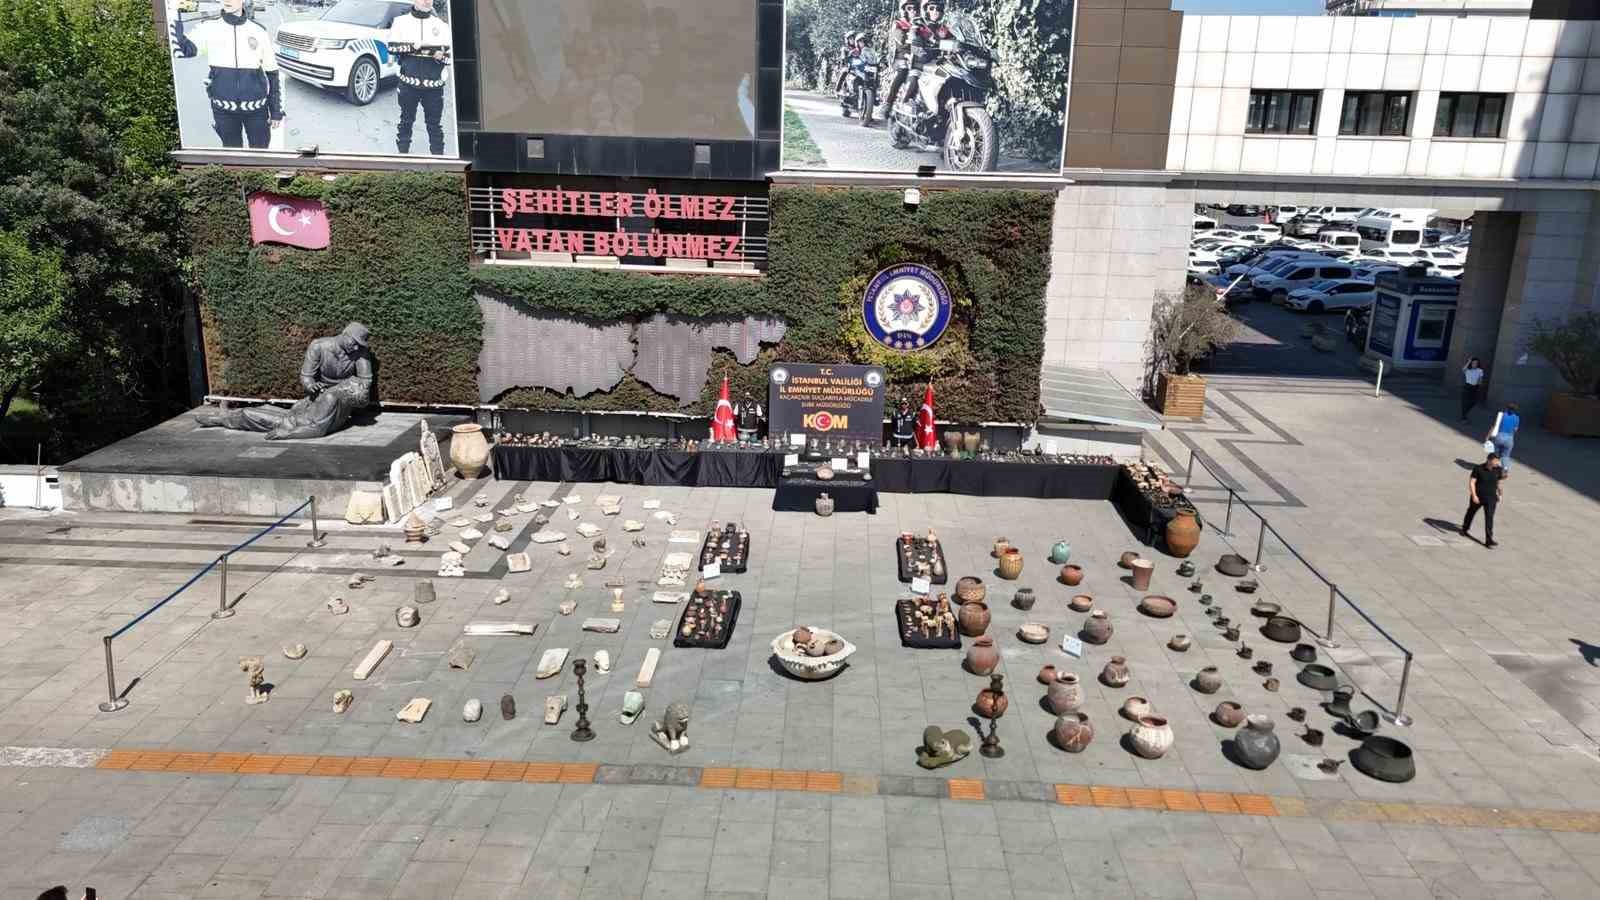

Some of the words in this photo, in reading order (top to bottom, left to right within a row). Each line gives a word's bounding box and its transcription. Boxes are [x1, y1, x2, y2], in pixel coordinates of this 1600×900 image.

[501, 185, 634, 219] ŞEHİTLER
[643, 188, 737, 220] ÖLMEZ
[496, 228, 584, 253] VATAN
[594, 228, 742, 260] BÖLÜNMEZ
[819, 368, 834, 376] T.C.
[791, 376, 829, 385] İSTANBUL
[830, 377, 863, 386] VALİLİĞİ
[779, 383, 786, 393] İL
[788, 385, 822, 394] EMNİYET
[822, 386, 874, 396] MÜDÜRLÜĞÜ
